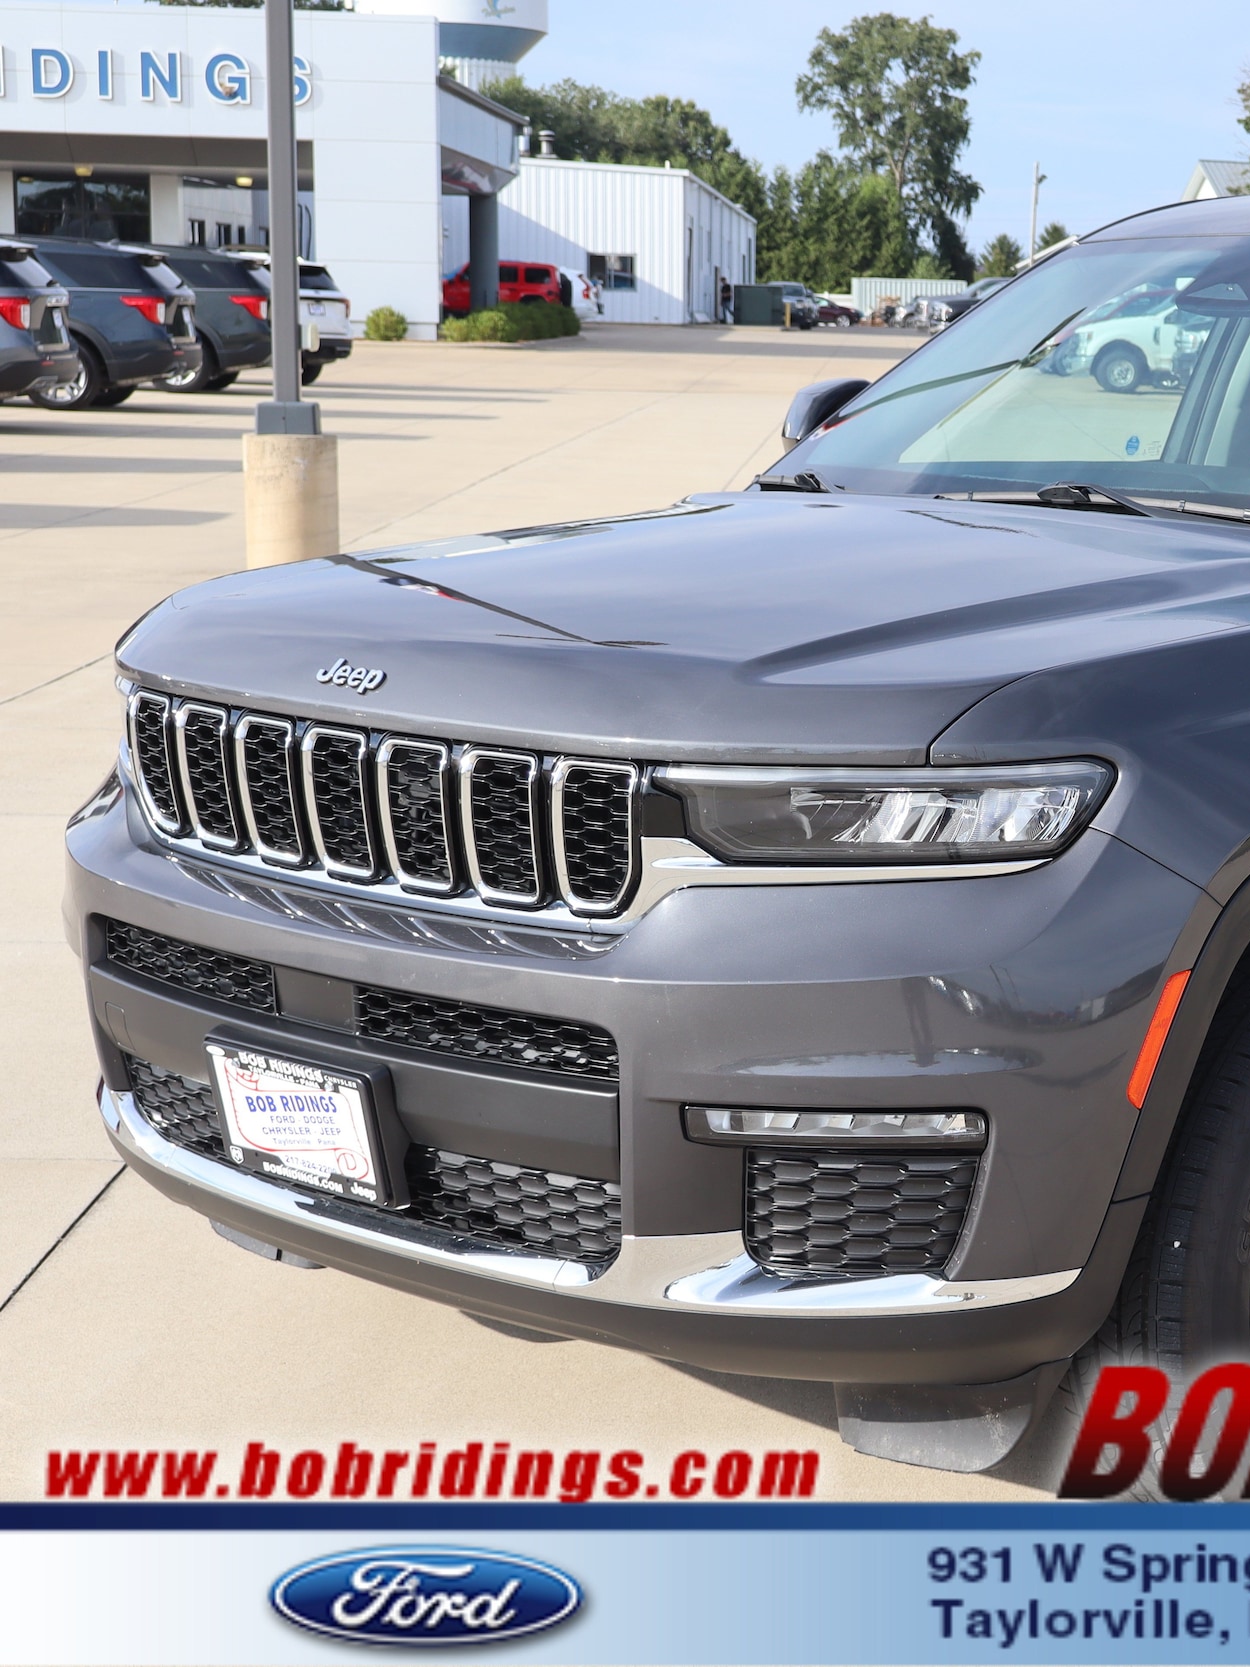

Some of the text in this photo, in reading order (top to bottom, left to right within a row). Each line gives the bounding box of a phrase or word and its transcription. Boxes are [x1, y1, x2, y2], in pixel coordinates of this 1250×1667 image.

[0, 47, 312, 106] DING
[316, 658, 387, 695] Jeep
[238, 1051, 323, 1083] BOB RIDINGS
[245, 1095, 337, 1113] BOB RIDINGS
[270, 1115, 296, 1124] FORD
[303, 1116, 336, 1125] DODGE
[262, 1127, 312, 1135] CHRYSLER
[320, 1128, 341, 1136] JEEP
[351, 1182, 377, 1202] Jeep
